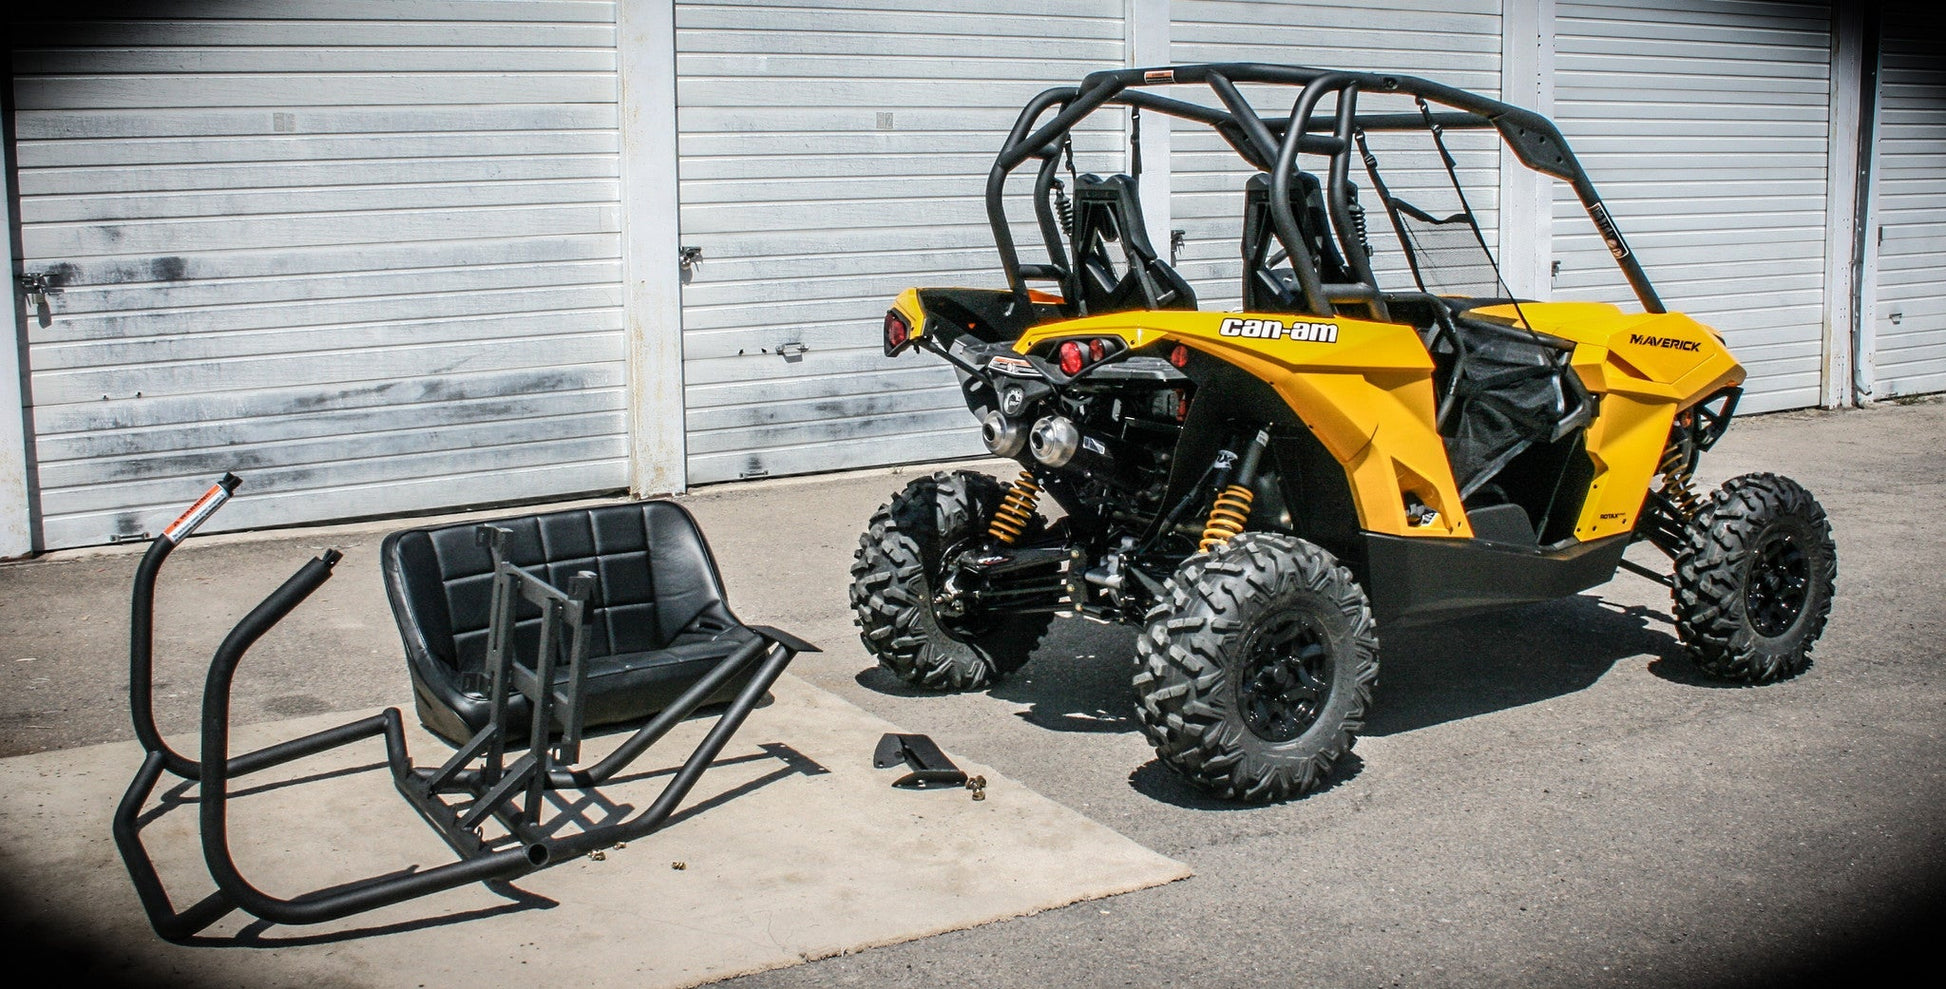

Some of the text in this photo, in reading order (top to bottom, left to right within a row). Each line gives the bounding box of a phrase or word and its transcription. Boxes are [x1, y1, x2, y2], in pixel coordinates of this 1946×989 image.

[1220, 318, 1338, 343] can-am
[1629, 334, 1701, 352] MAVERICK
[180, 493, 211, 519] WARNING
